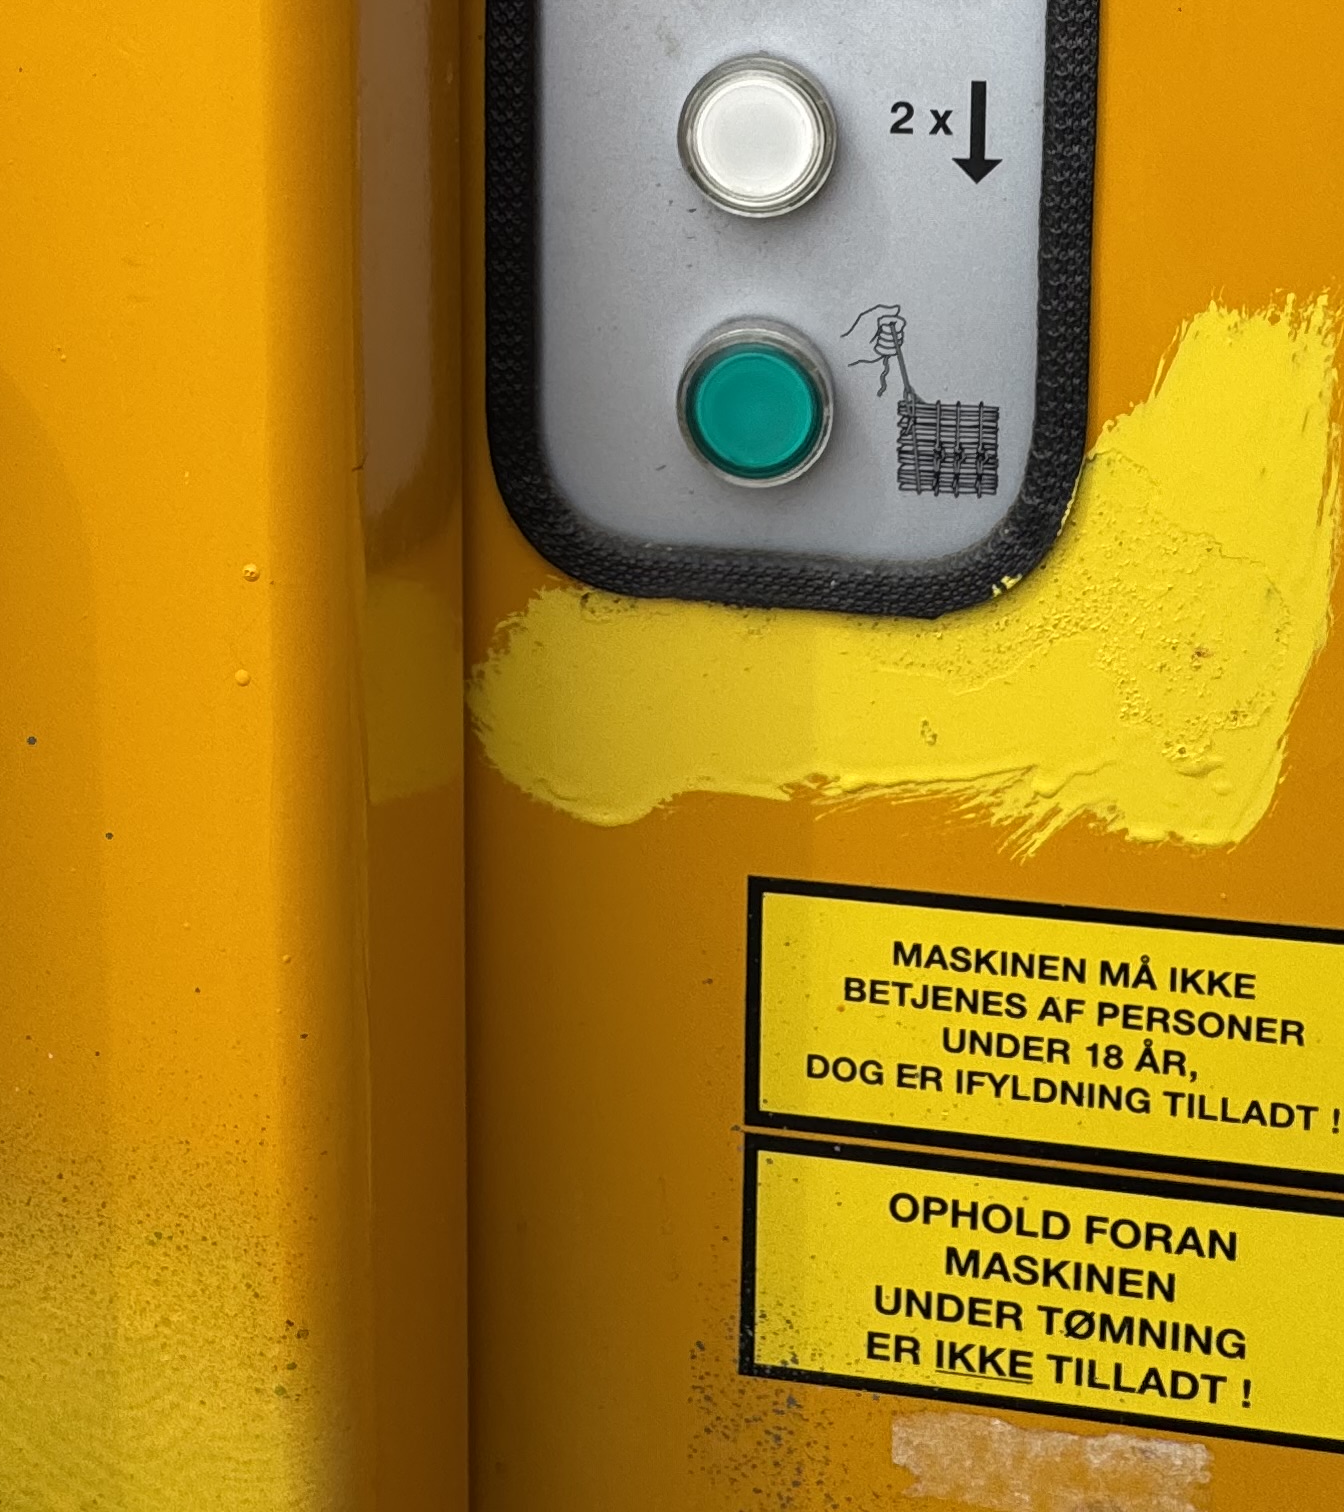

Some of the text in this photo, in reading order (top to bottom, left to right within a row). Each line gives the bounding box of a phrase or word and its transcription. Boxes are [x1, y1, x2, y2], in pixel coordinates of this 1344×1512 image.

[889, 100, 953, 136] 2 x
[893, 941, 1257, 1000] MASKINEN MÅ IKKE
[844, 977, 1305, 1047] BETJENES AF PERSONER
[942, 1027, 1198, 1083] UNDER 18 ÅR,
[806, 1054, 1341, 1134] DOG ER IFYLDNING TILLADT !
[889, 1193, 1237, 1262] OPHOLD FORAN
[945, 1247, 1176, 1303] MASKINEN
[874, 1285, 1246, 1360] UNDER TØMNING
[866, 1331, 1252, 1408] ER IKKE TILLADT !
